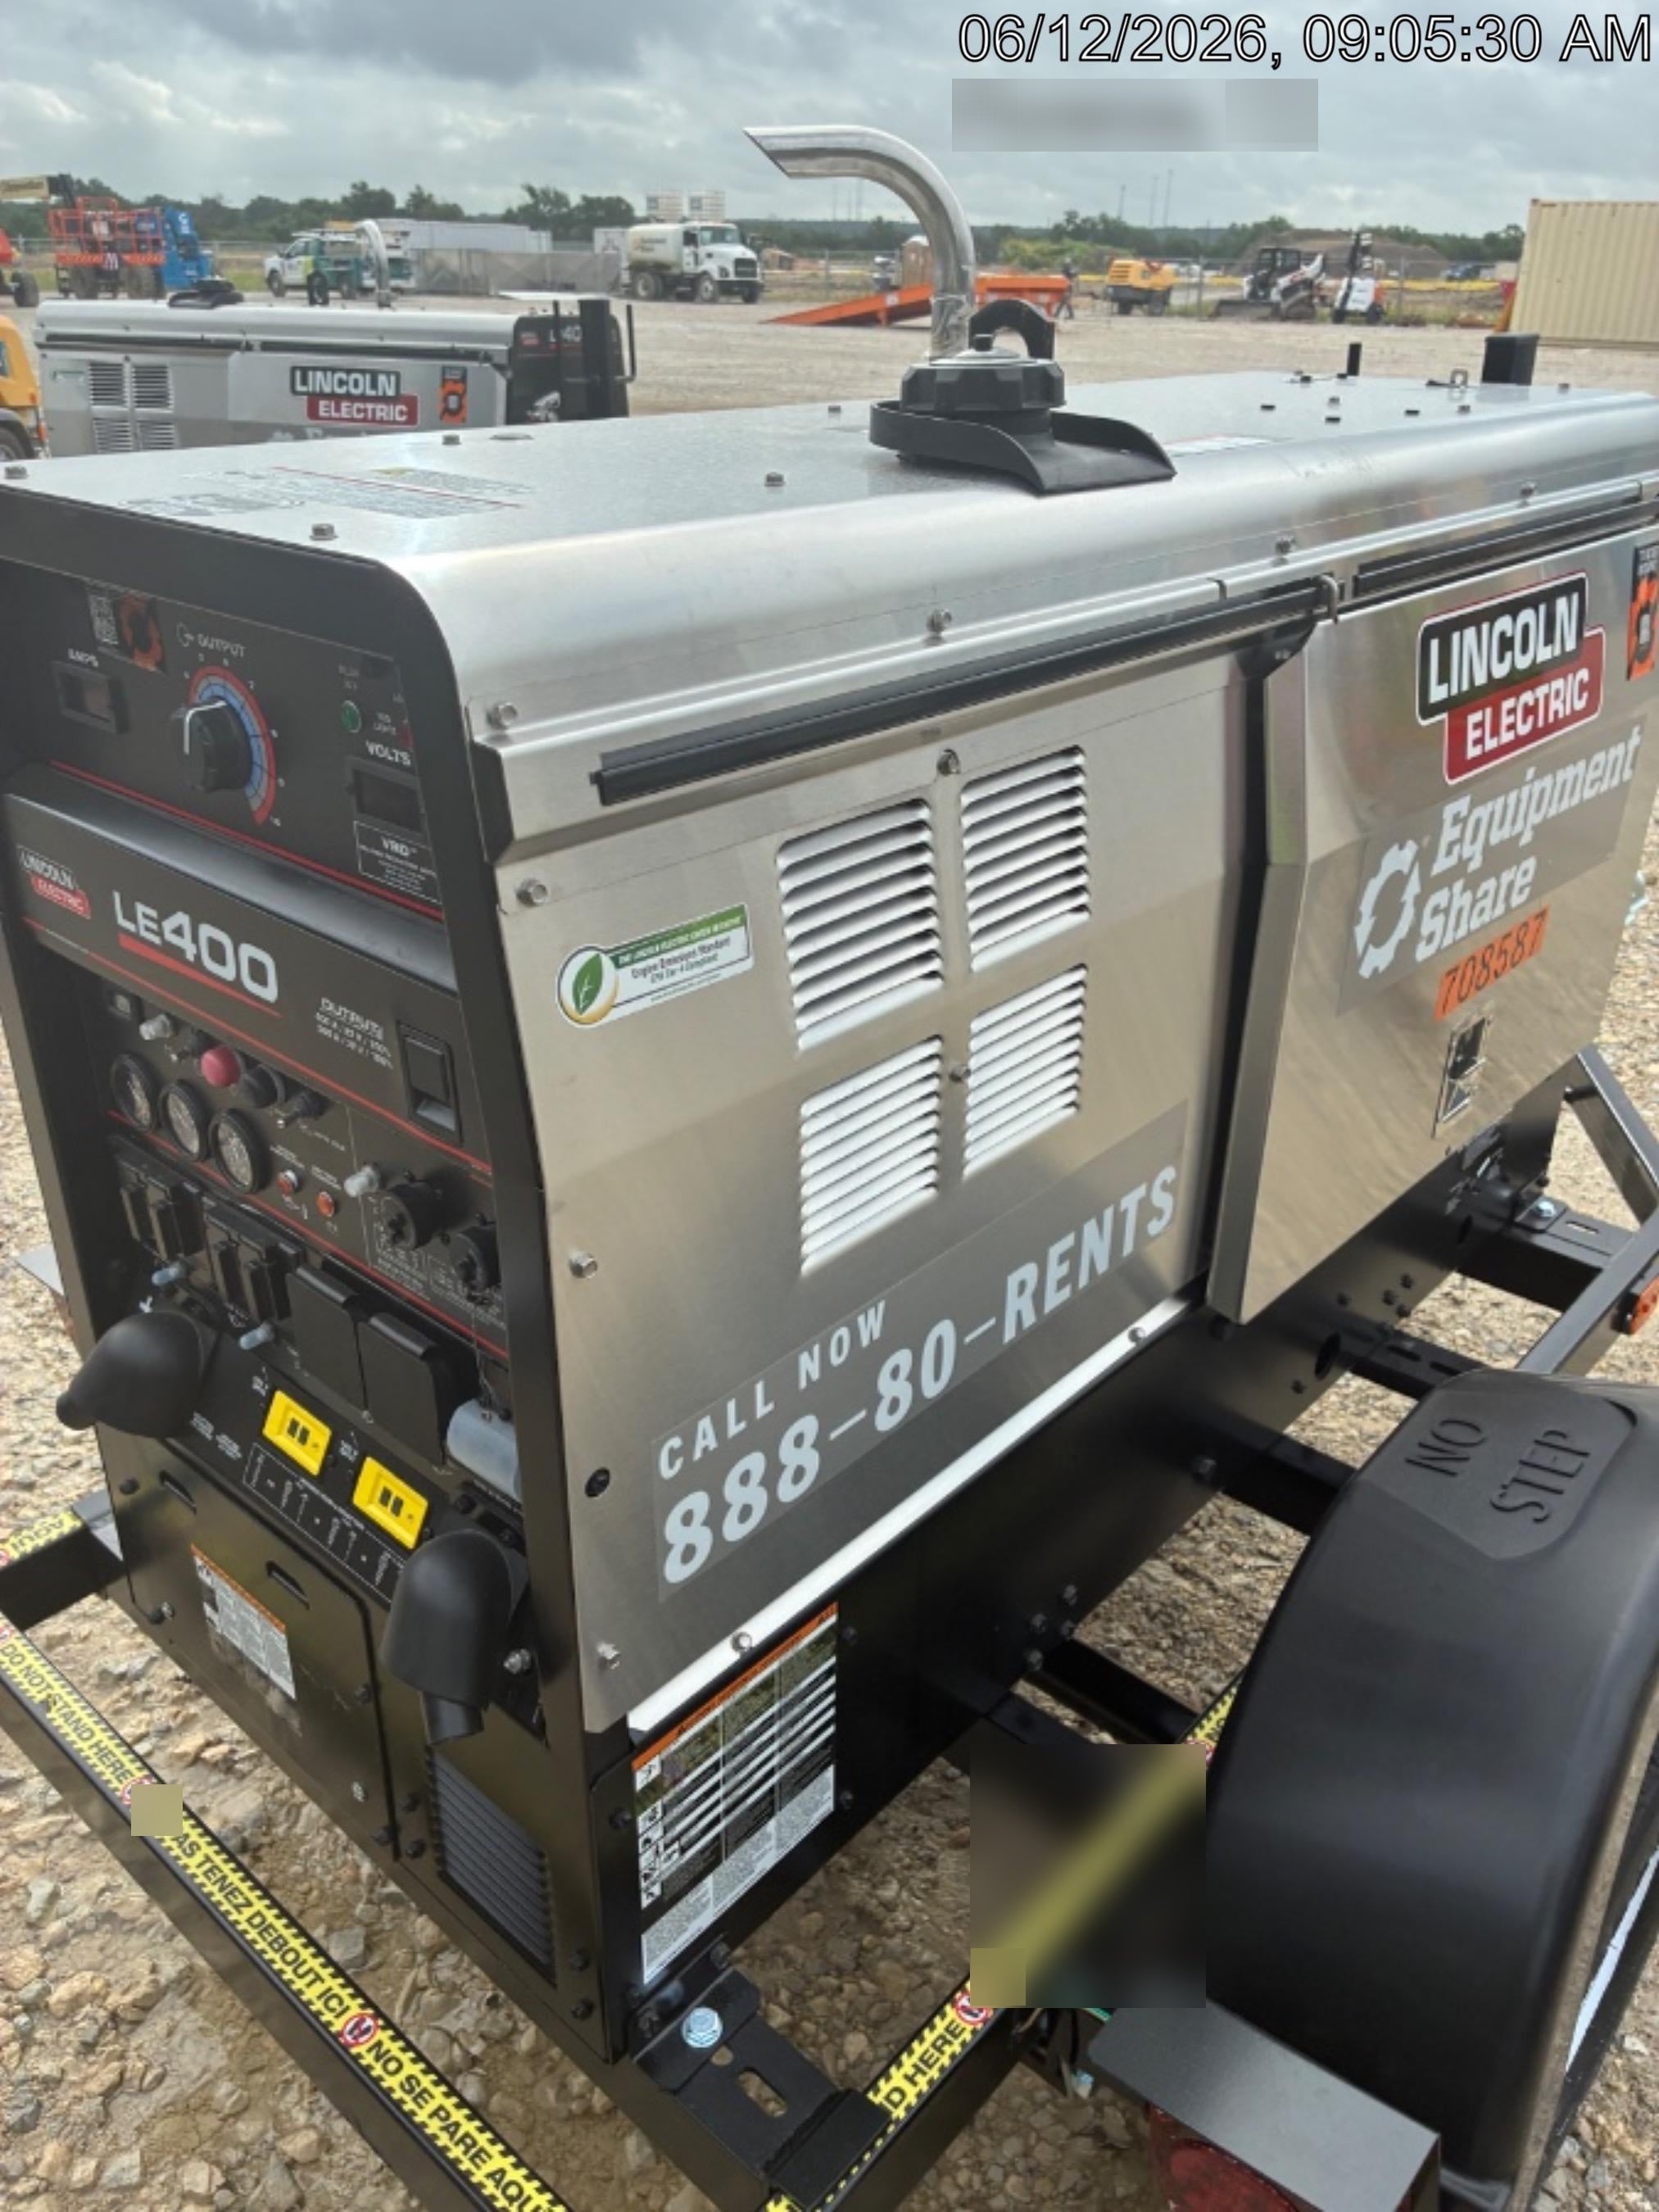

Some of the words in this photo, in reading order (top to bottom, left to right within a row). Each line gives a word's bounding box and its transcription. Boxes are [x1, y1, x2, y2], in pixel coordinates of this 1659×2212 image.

[294, 370, 397, 397] LINCOLN
[318, 400, 409, 421] ELECTRIC
[197, 634, 246, 657] OUTPUT
[1429, 592, 1580, 705] LINCOLN
[365, 740, 411, 766] VOLTS
[1466, 668, 1590, 760] ELECTRIC
[1430, 724, 1642, 877] Equipment
[112, 890, 279, 1004] LE400
[1415, 855, 1537, 963] Share
[1442, 909, 1548, 1014] 708587
[658, 1380, 774, 1480] CALL
[797, 1300, 886, 1390] NOW
[1404, 1419, 1489, 1476] NO
[1489, 1430, 1591, 1524] STEP
[1, 1643, 25, 1666] DO
[19, 1665, 56, 1697] NOT
[46, 1691, 97, 1742] STAND
[87, 1736, 134, 1783] HERE
[193, 1852, 253, 1915] TENEZ
[247, 1910, 324, 1989] DEBOUT
[318, 1979, 351, 2019] ICI
[904, 2017, 966, 2087] HERE
[367, 2038, 404, 2077] NO
[399, 2072, 435, 2109] SE
[428, 2104, 493, 2172] PARE
